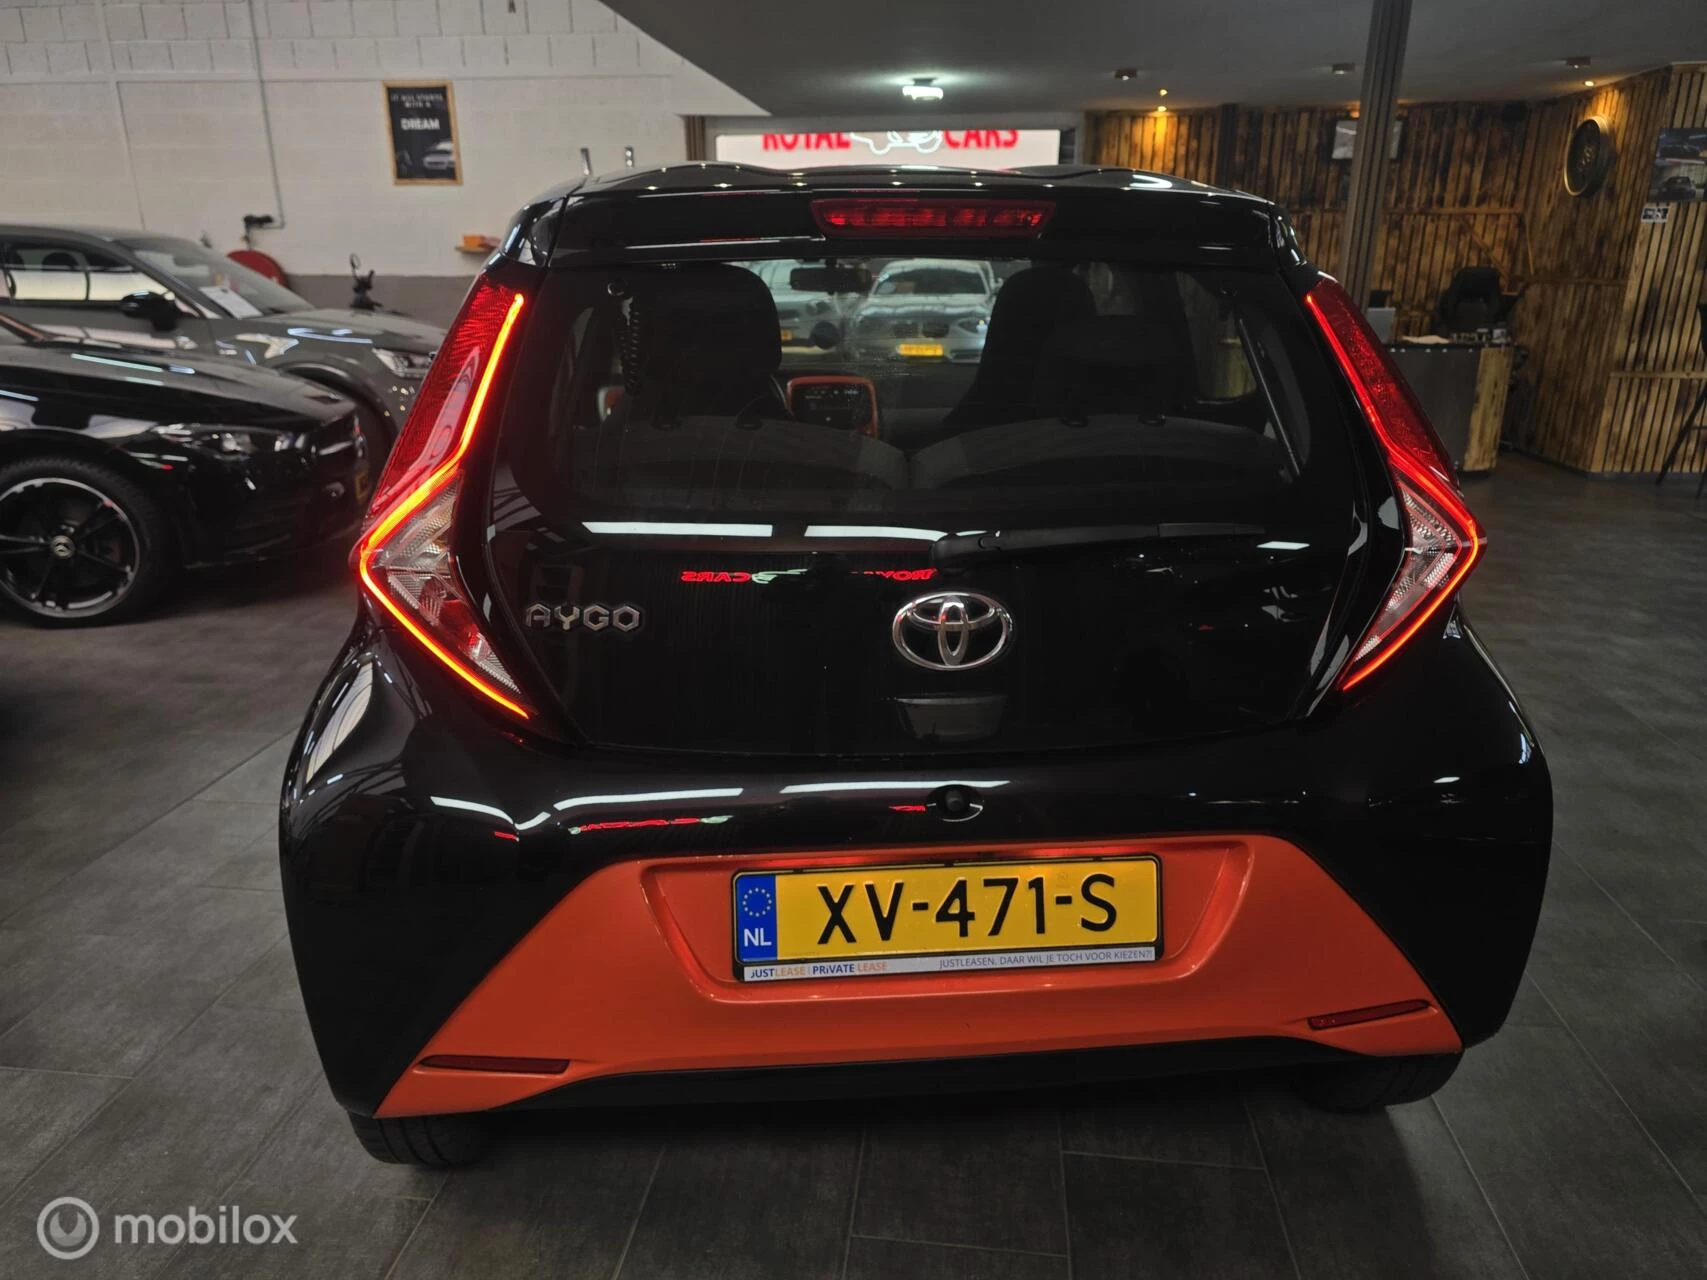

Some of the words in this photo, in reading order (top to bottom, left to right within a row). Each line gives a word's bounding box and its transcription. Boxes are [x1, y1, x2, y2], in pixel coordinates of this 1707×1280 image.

[401, 118, 440, 130] DREAM
[525, 603, 640, 632] AYGO
[817, 873, 1118, 945] XV-471-S
[743, 927, 772, 947] NL
[857, 961, 888, 972] LEASE
[1000, 955, 1025, 965] DAAR
[1026, 954, 1045, 964] WIL
[1045, 953, 1053, 965] JE
[1057, 953, 1083, 963] TOCH
[1085, 951, 1112, 961] VOOR
